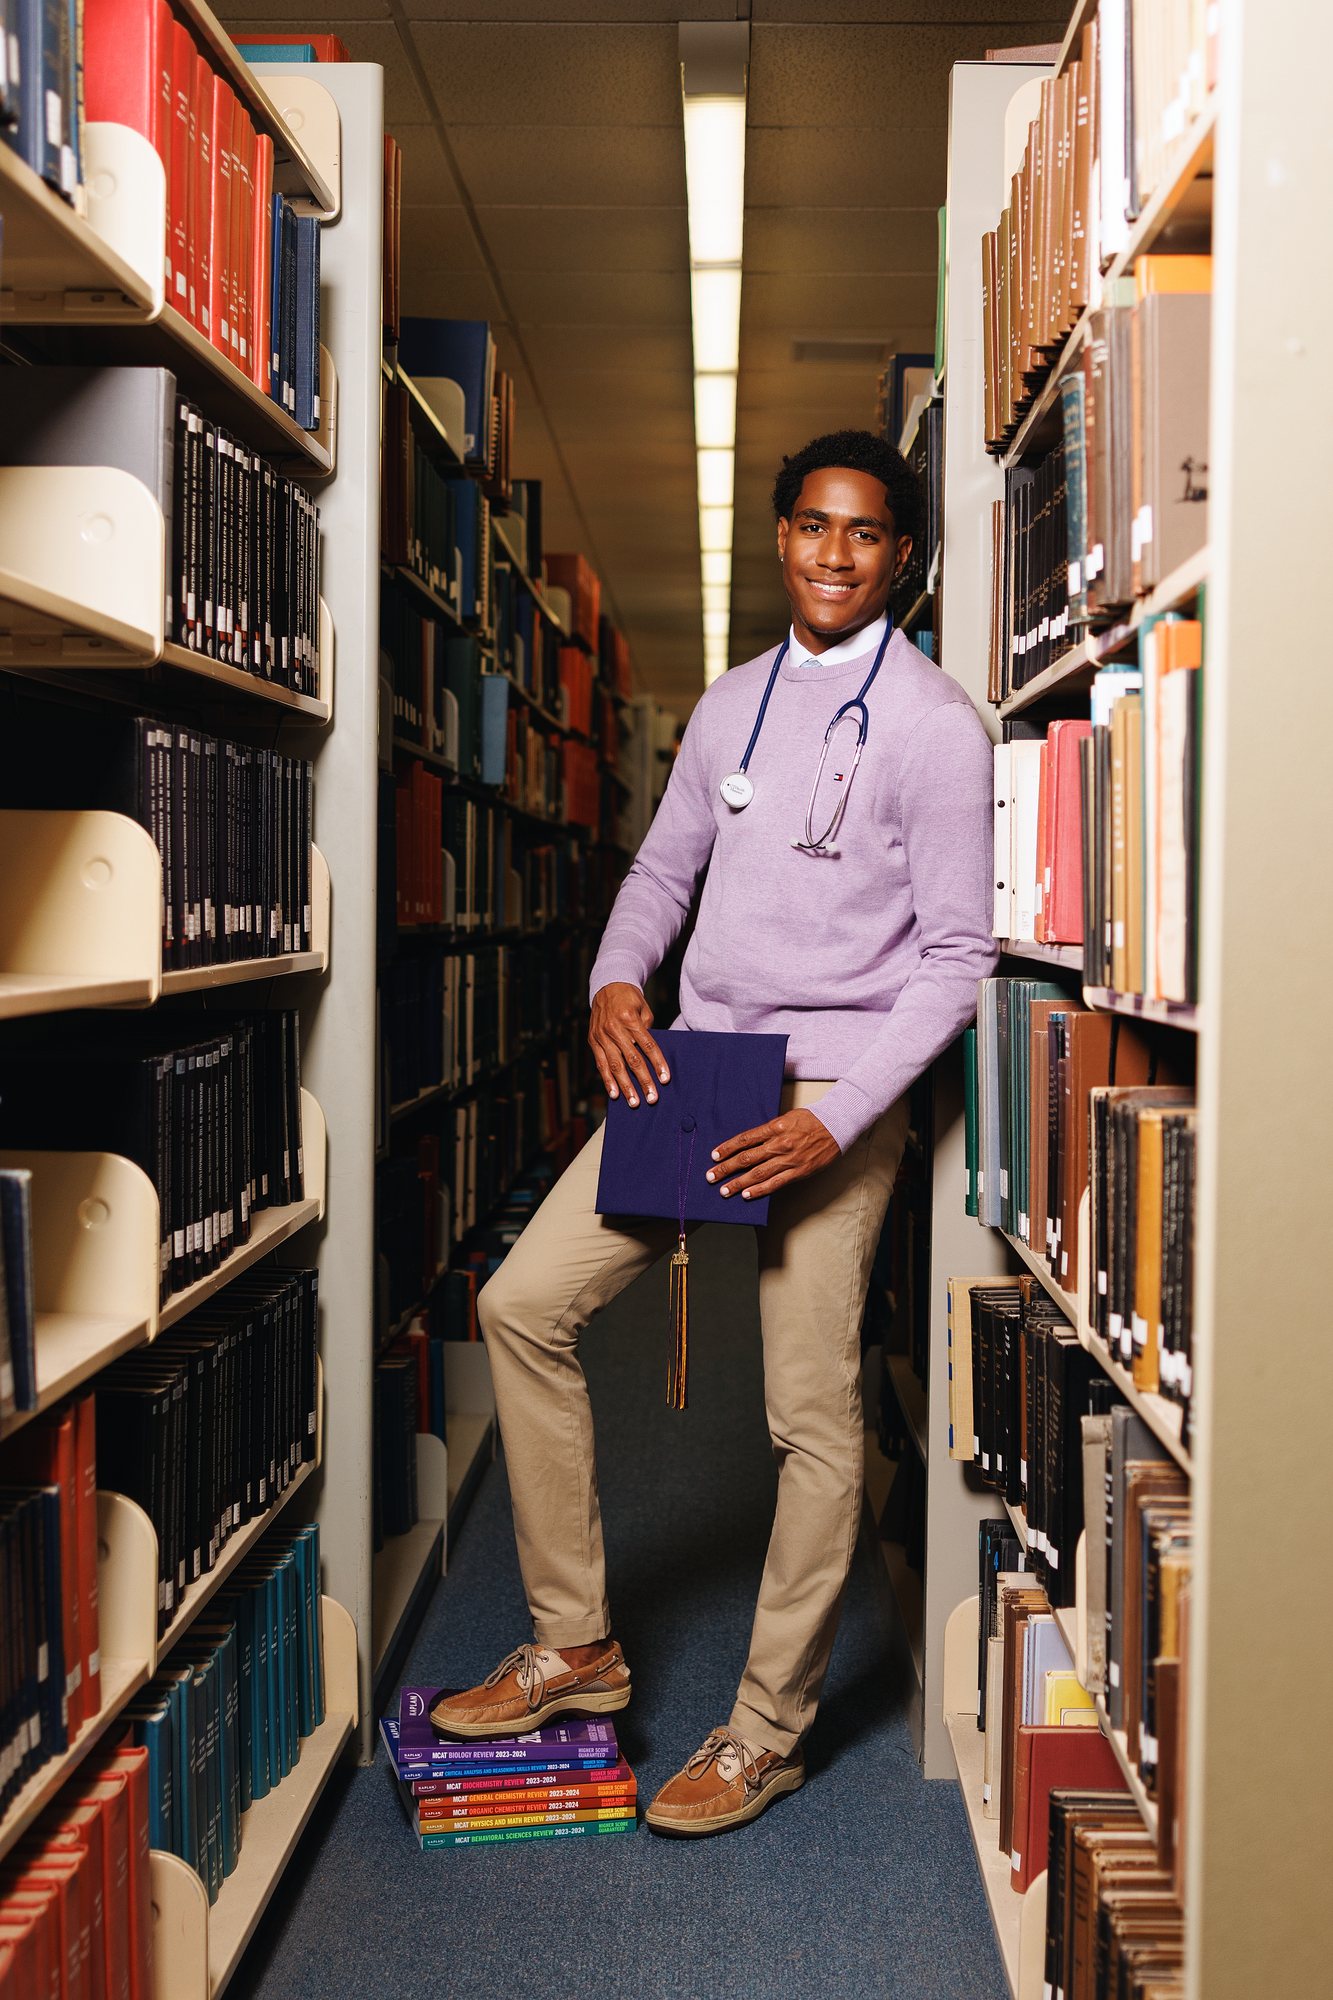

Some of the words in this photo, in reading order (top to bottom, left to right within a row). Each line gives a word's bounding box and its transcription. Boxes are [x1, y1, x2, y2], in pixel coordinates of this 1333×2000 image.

[994, 1551, 998, 1571] 4
[409, 1695, 417, 1716] KAPLAN
[388, 1722, 400, 1739] KAPLAN
[463, 1780, 503, 1789] BIOCHEMISTRY
[504, 1778, 525, 1786] REVIEW
[526, 1777, 556, 1785] 2023-2024
[469, 1793, 493, 1802] GENERAL
[495, 1792, 526, 1800] CHEMISTRY
[549, 1789, 579, 1797] 2023-2024
[469, 1807, 493, 1815] ORGANIC
[495, 1805, 525, 1813] CHEMISTRY
[527, 1803, 547, 1811] REVIEW
[549, 1802, 578, 1810] 2023-2024
[472, 1834, 504, 1842] BEHAVIORAL
[555, 1827, 584, 1835] 2023-2024
